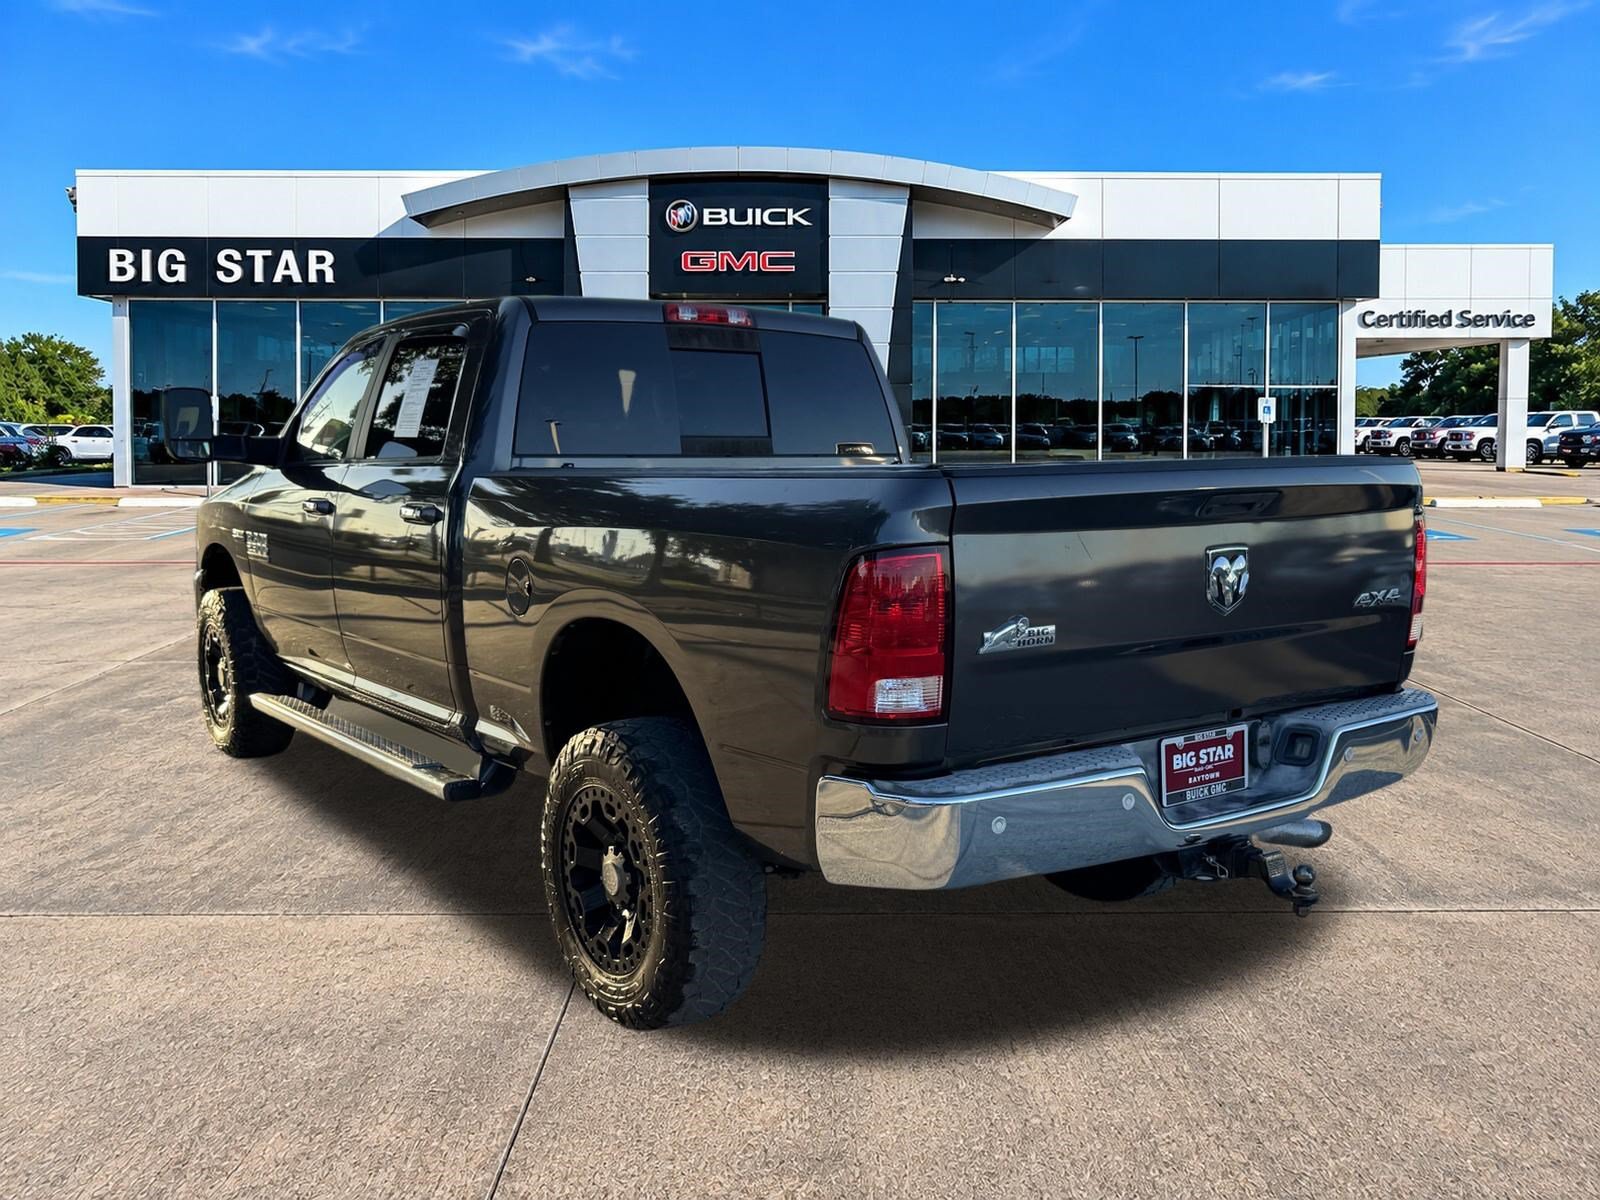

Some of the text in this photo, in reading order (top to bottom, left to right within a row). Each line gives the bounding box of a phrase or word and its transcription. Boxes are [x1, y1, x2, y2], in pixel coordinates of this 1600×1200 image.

[702, 208, 813, 226] BUICK
[109, 249, 336, 283] BIG STAR
[681, 251, 795, 272] GMC
[1359, 310, 1536, 329] Certified Service
[1017, 635, 1054, 647] HORN
[1027, 627, 1049, 638] BIG
[1173, 744, 1234, 770] BIG STAR
[1188, 771, 1220, 784] BAYTOWN
[1186, 782, 1227, 800] BUICK GMC
